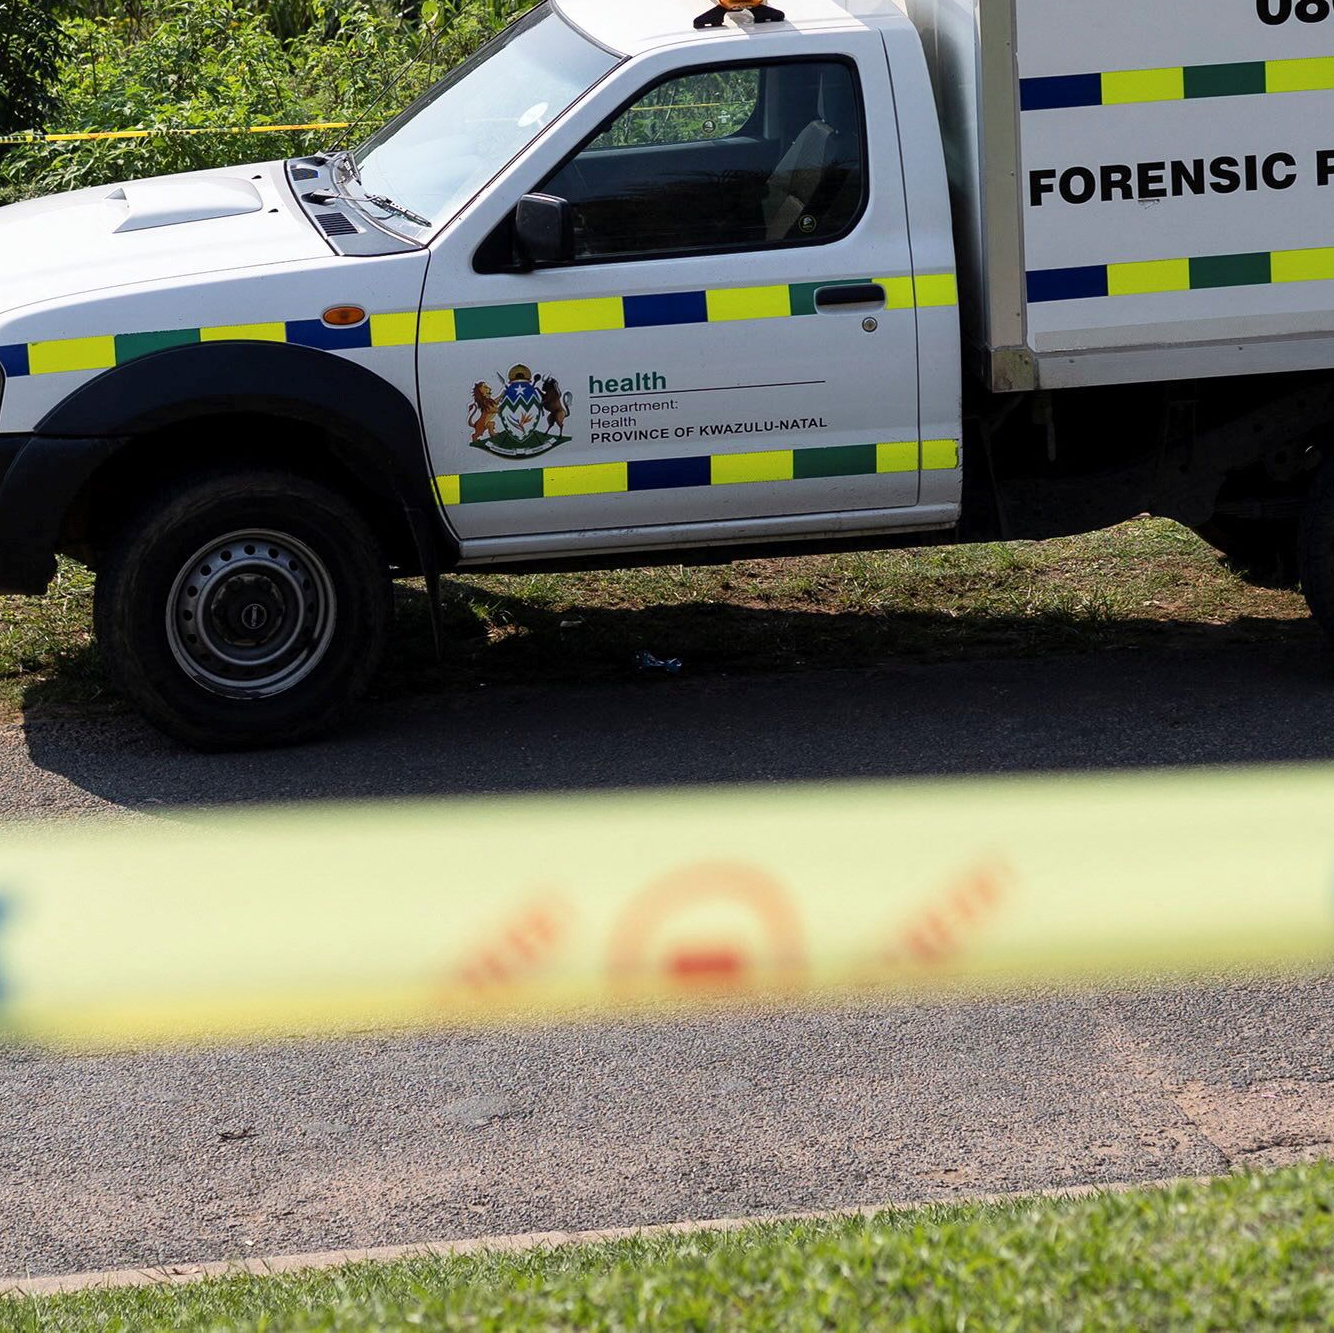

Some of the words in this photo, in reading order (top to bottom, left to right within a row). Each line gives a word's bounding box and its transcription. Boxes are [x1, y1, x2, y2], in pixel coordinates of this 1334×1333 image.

[1029, 152, 1297, 207] FORENSIC
[588, 372, 667, 394] health
[589, 400, 679, 416] Department:
[590, 417, 637, 429] Health
[591, 429, 670, 443] PROVINCE
[674, 426, 695, 437] OF
[699, 418, 828, 436] KWAZULU-NATAL
